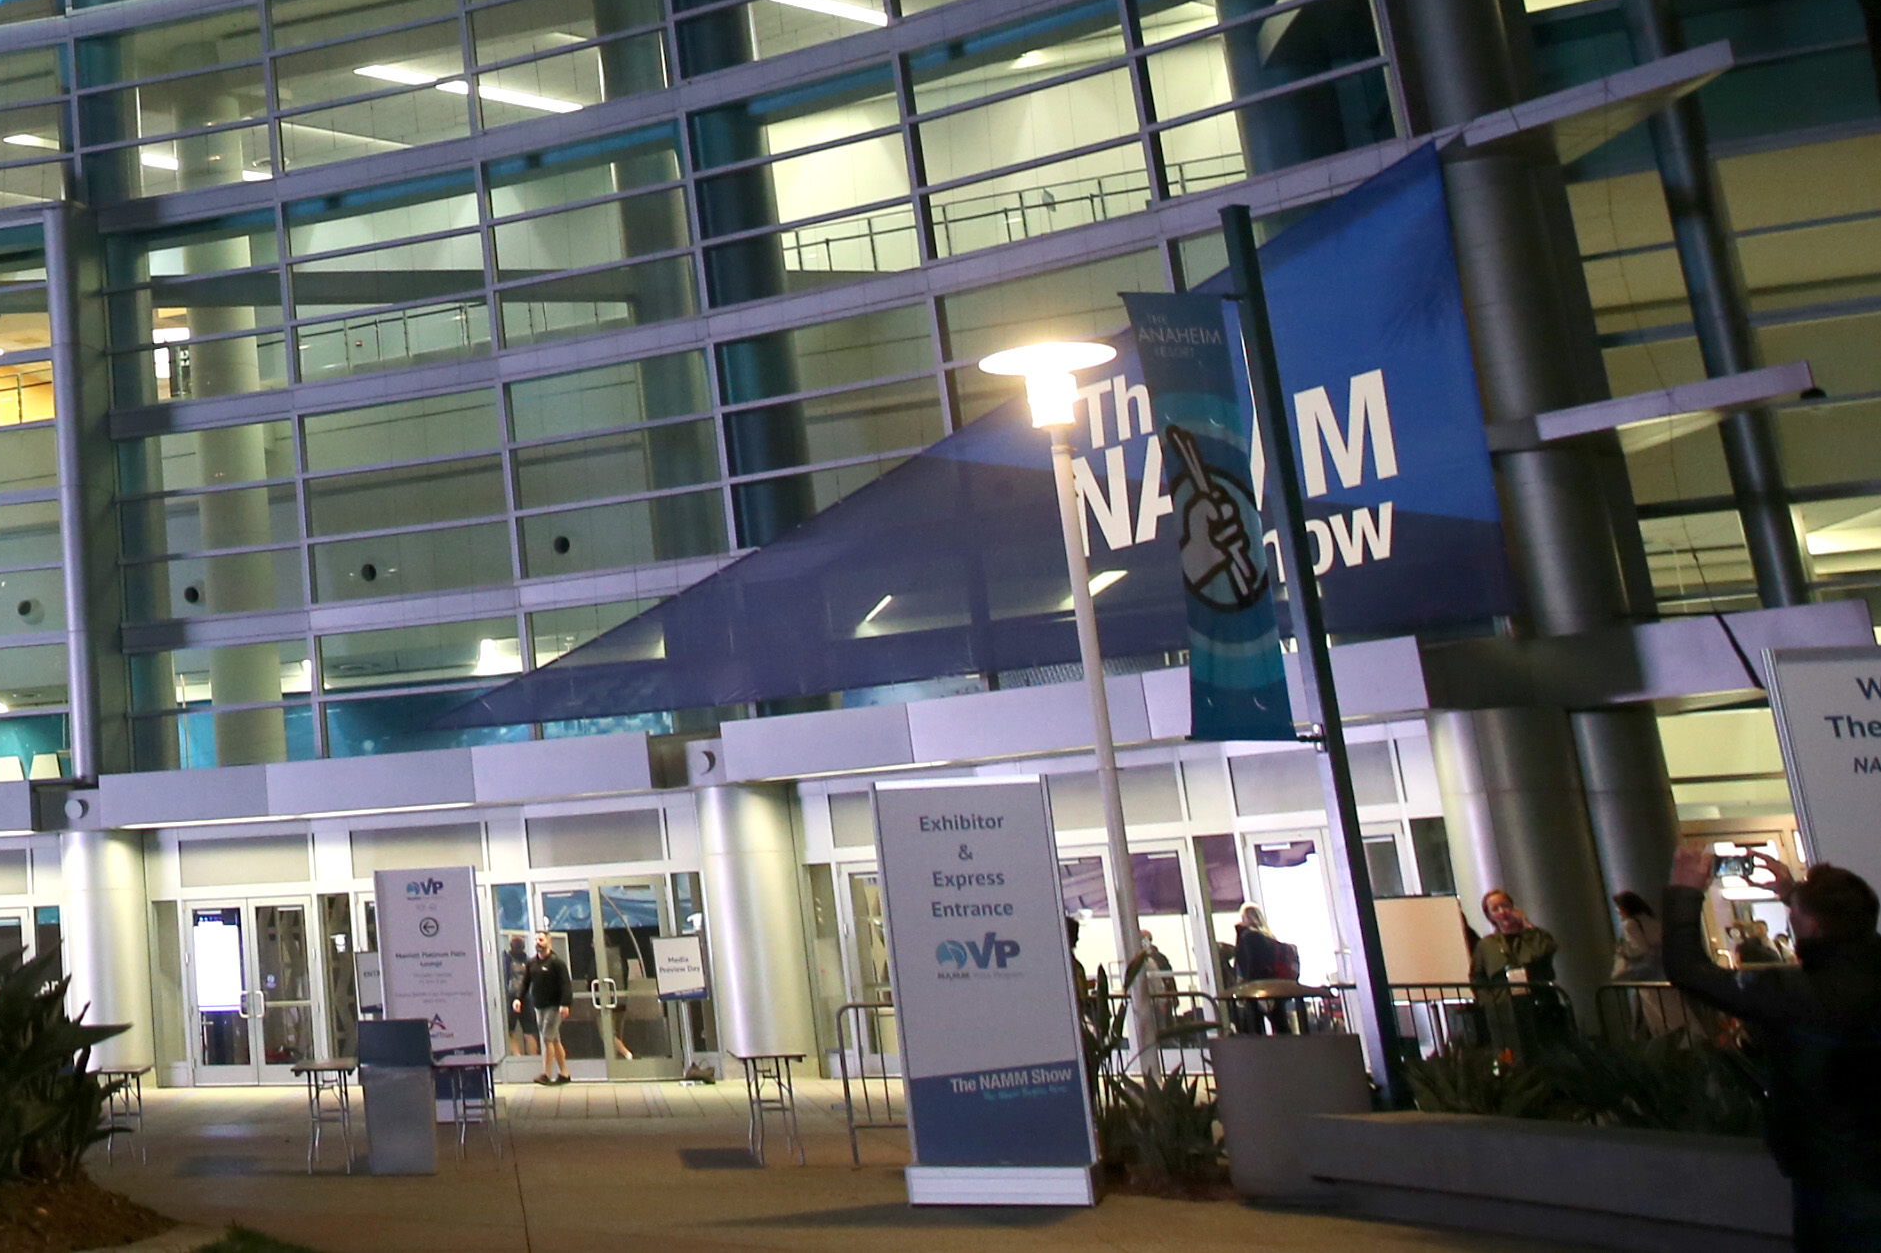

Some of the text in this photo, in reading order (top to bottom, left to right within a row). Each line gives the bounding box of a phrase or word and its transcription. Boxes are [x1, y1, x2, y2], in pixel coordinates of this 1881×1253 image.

[1138, 326, 1223, 345] ANAHEIM
[1075, 374, 1154, 450] Th
[919, 813, 1004, 832] Exhibitor
[958, 844, 973, 861] &
[932, 871, 1005, 891] Express
[931, 901, 1014, 918] Entrance
[950, 1077, 977, 1094] The
[979, 1071, 1028, 1090] NAMM
[1031, 1068, 1073, 1085] Show
